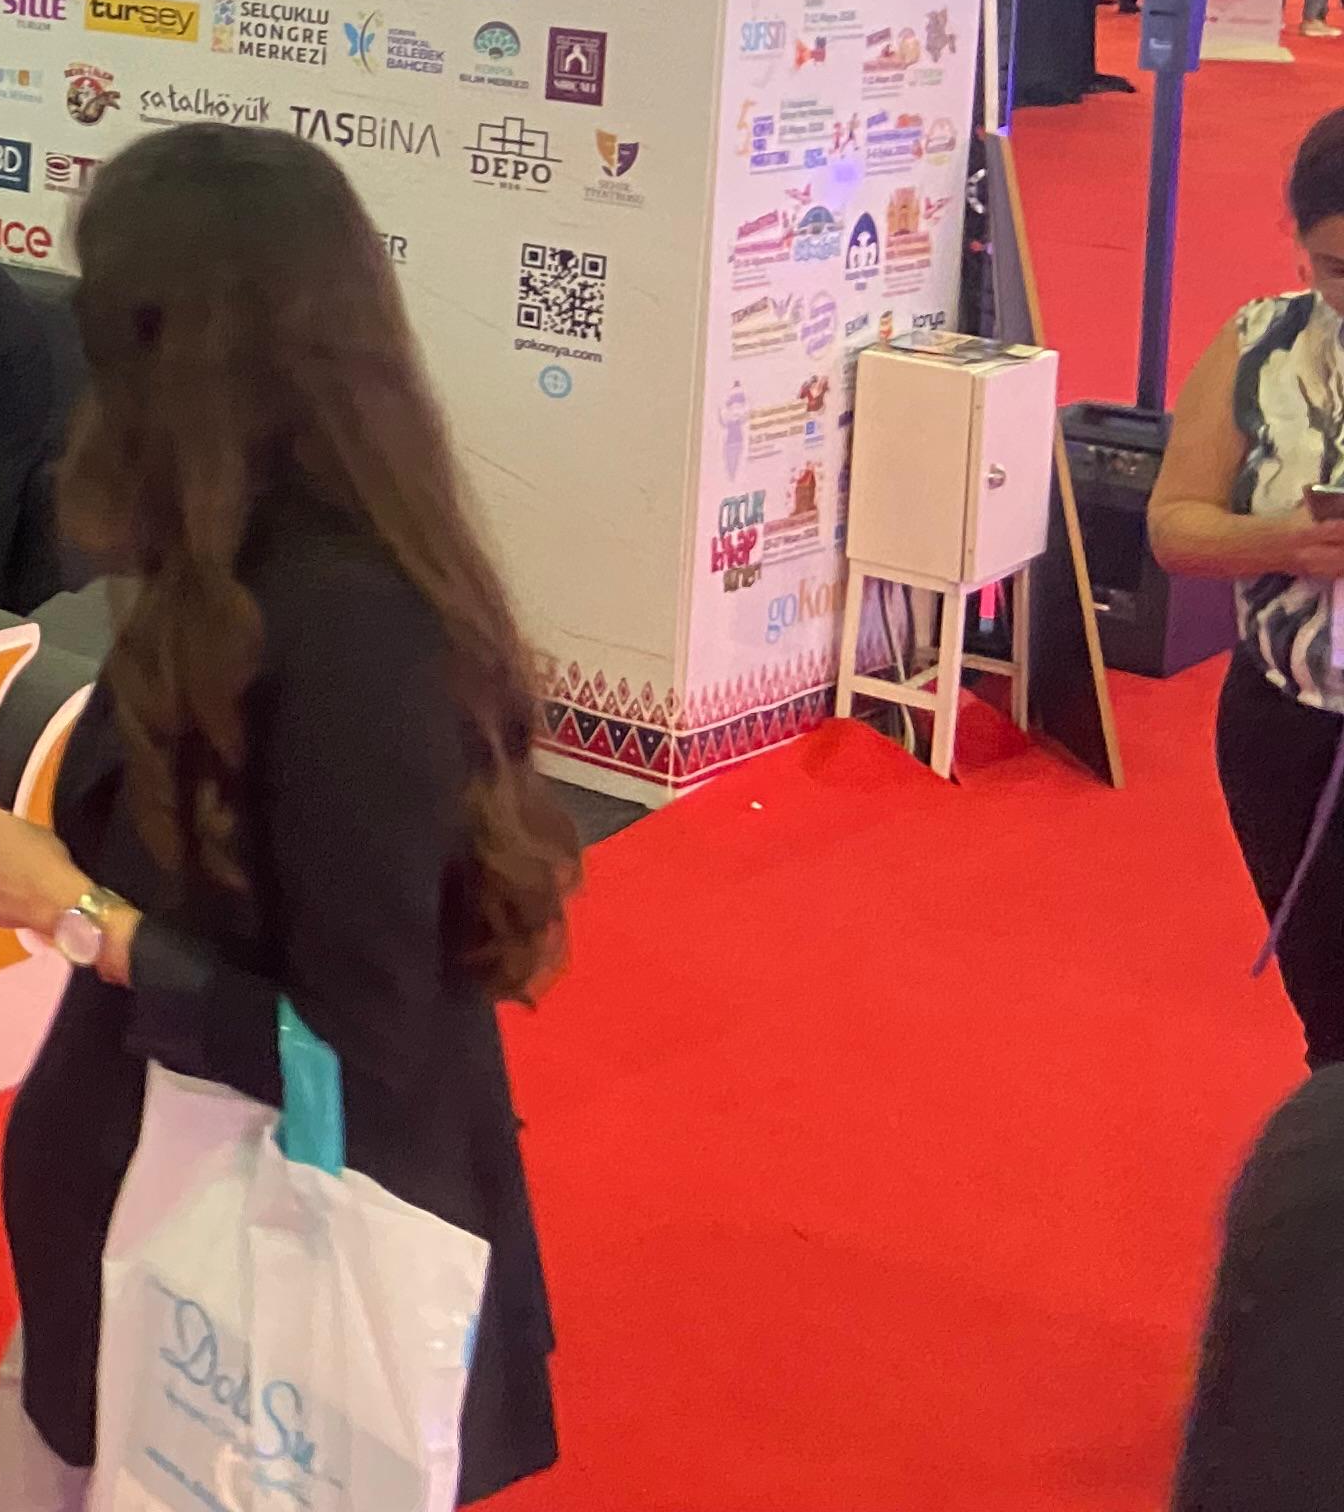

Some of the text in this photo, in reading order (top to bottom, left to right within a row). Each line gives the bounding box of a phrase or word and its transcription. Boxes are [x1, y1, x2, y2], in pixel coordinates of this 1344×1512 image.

[241, 1, 329, 25] SELÇUKLU
[239, 21, 328, 45] KONGRE
[238, 40, 327, 66] MERKEZİ
[471, 154, 552, 185] DEPO
[514, 338, 603, 363] gokonya.com
